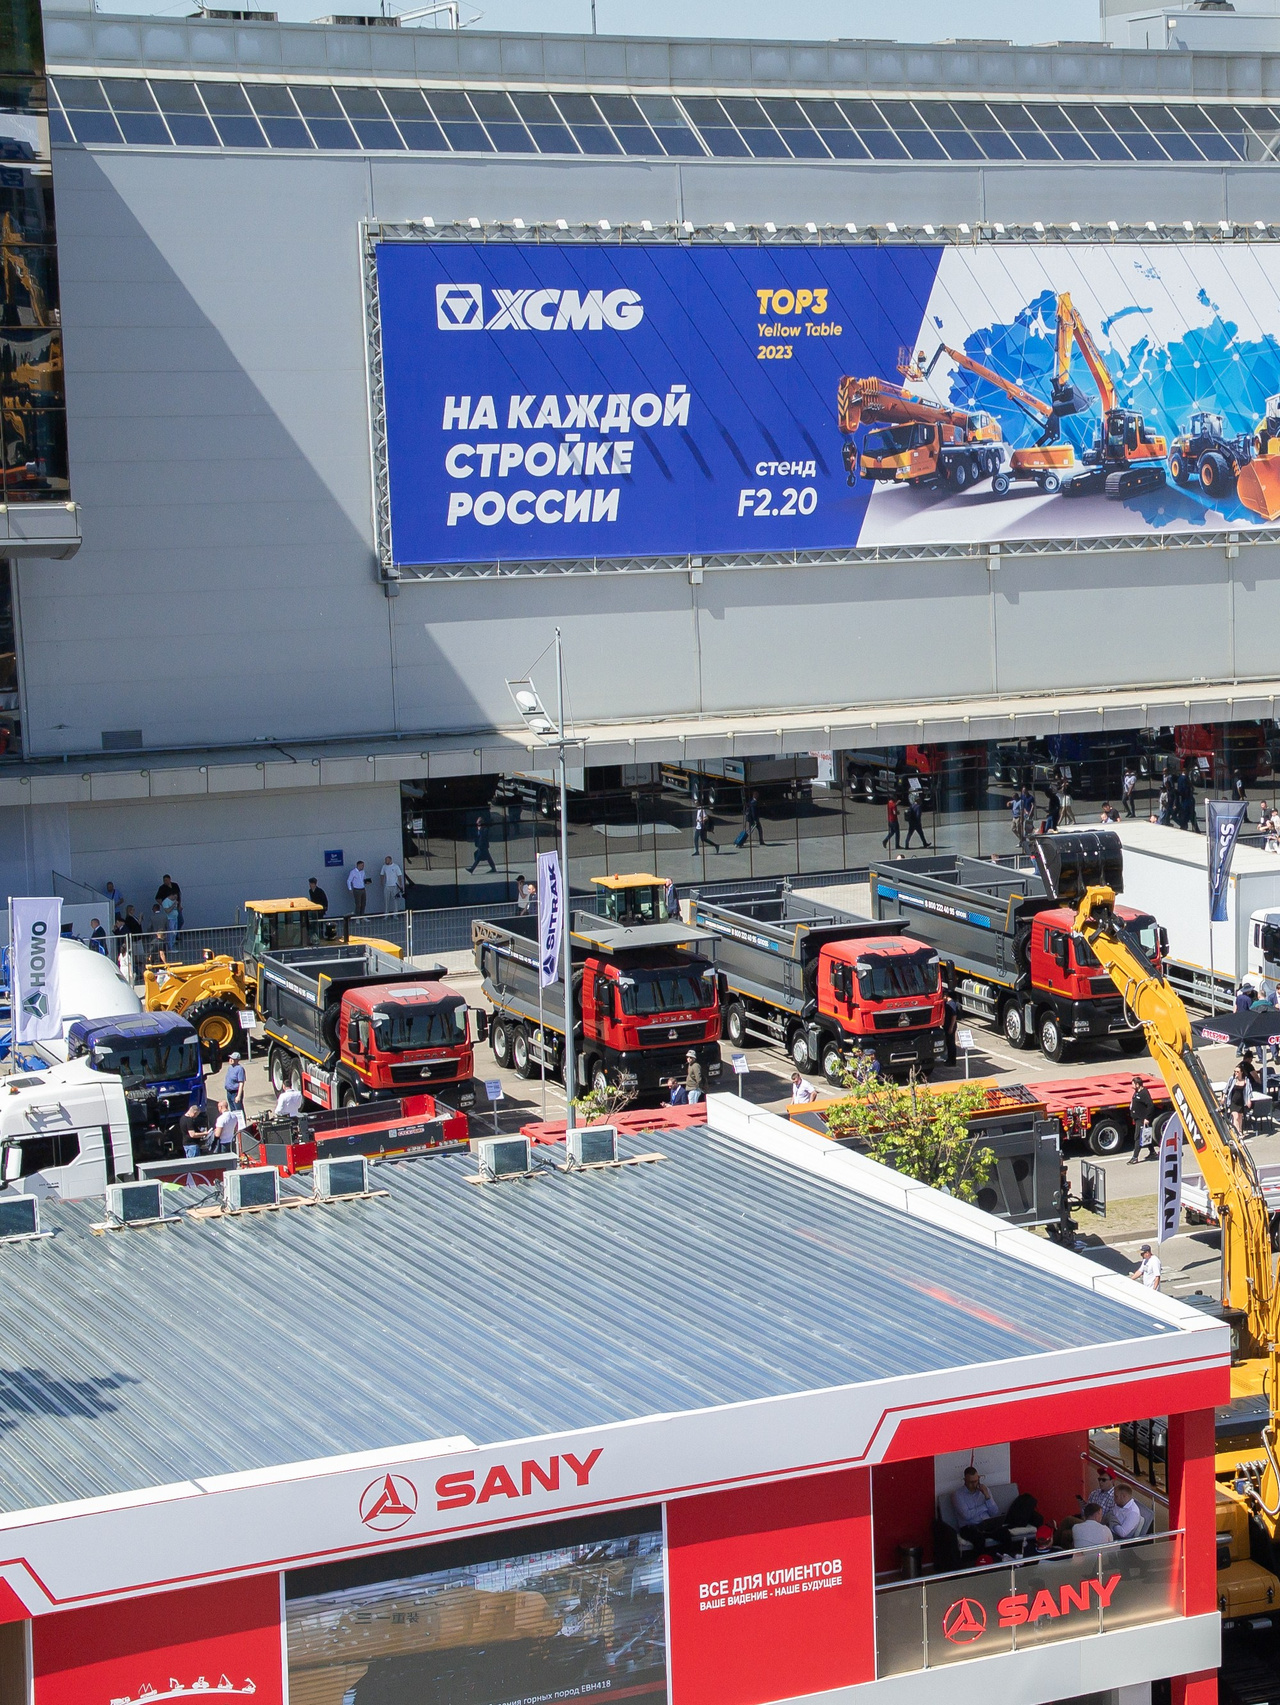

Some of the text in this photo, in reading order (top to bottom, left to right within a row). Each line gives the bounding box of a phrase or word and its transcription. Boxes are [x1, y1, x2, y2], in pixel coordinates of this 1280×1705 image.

[485, 289, 644, 330] XCMG
[757, 288, 828, 315] TOP3
[757, 321, 843, 338] Yellow Table
[757, 345, 793, 360] 2023
[443, 385, 691, 433] НА КАЖДОЙ
[445, 434, 635, 478] СТРОЙКЕ
[756, 460, 816, 479] стенд
[446, 488, 621, 526] РОССИИ
[738, 487, 818, 517] F2.20
[546, 863, 559, 950] SITRAK
[30, 921, 47, 987] HOWO
[1174, 1087, 1202, 1142] SANY
[1164, 1131, 1178, 1231] TITAN
[435, 1448, 604, 1511] SANY
[699, 1559, 842, 1598] ВСЕ ДЛЯ КЛИЕНТОВ
[700, 1598, 726, 1611] ВАШЕ
[728, 1590, 768, 1606] ВИДЕНИЕ
[774, 1584, 800, 1597] НАШЕ
[802, 1576, 842, 1592] БУДУЩЕЕ
[997, 1574, 1122, 1628] SANY
[523, 1694, 553, 1705] горных
[554, 1688, 580, 1698] пород
